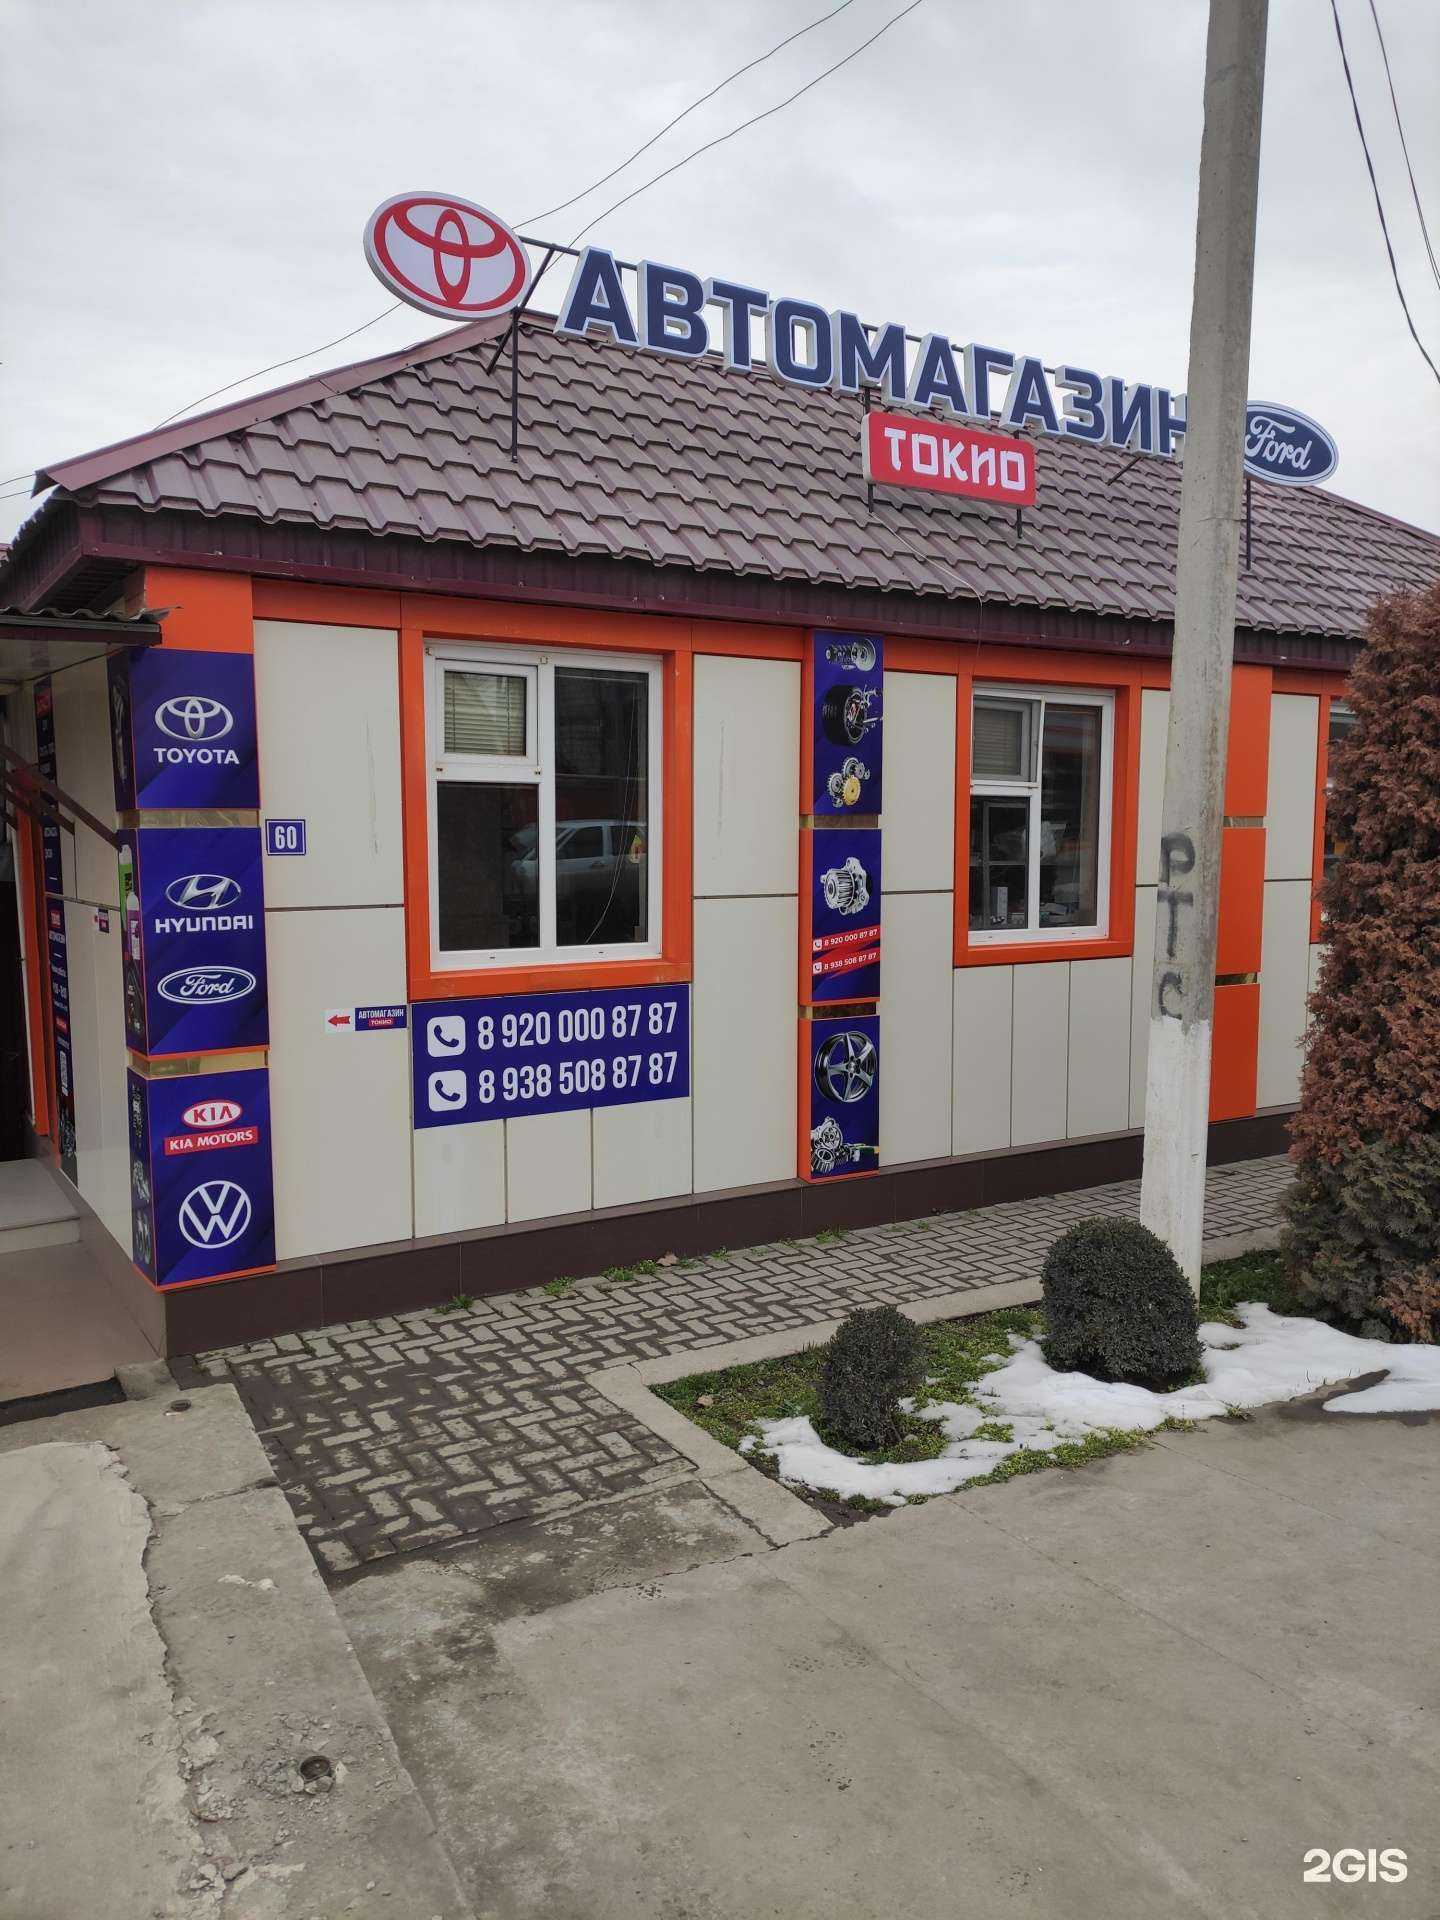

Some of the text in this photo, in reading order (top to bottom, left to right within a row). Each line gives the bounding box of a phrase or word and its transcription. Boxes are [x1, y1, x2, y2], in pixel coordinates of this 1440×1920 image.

[552, 245, 1188, 458] АВТОМАГАЗИН
[1244, 414, 1312, 471] Ford
[153, 747, 240, 765] TOYOTA
[274, 825, 298, 850] 60
[155, 914, 254, 934] HYUNDAI
[830, 937, 844, 945] 920
[844, 933, 858, 942] 000
[859, 930, 868, 939] 87
[869, 928, 878, 937] 87
[830, 959, 843, 969] 938
[179, 973, 236, 997] Ford
[358, 1008, 405, 1020] АВТОМАГАЗИН
[477, 1001, 678, 1050] 8 920 000 87 87
[478, 1051, 678, 1104] 8 938 508 87 87
[193, 1105, 233, 1123] KIA
[169, 1129, 254, 1151] KIA MOTORS
